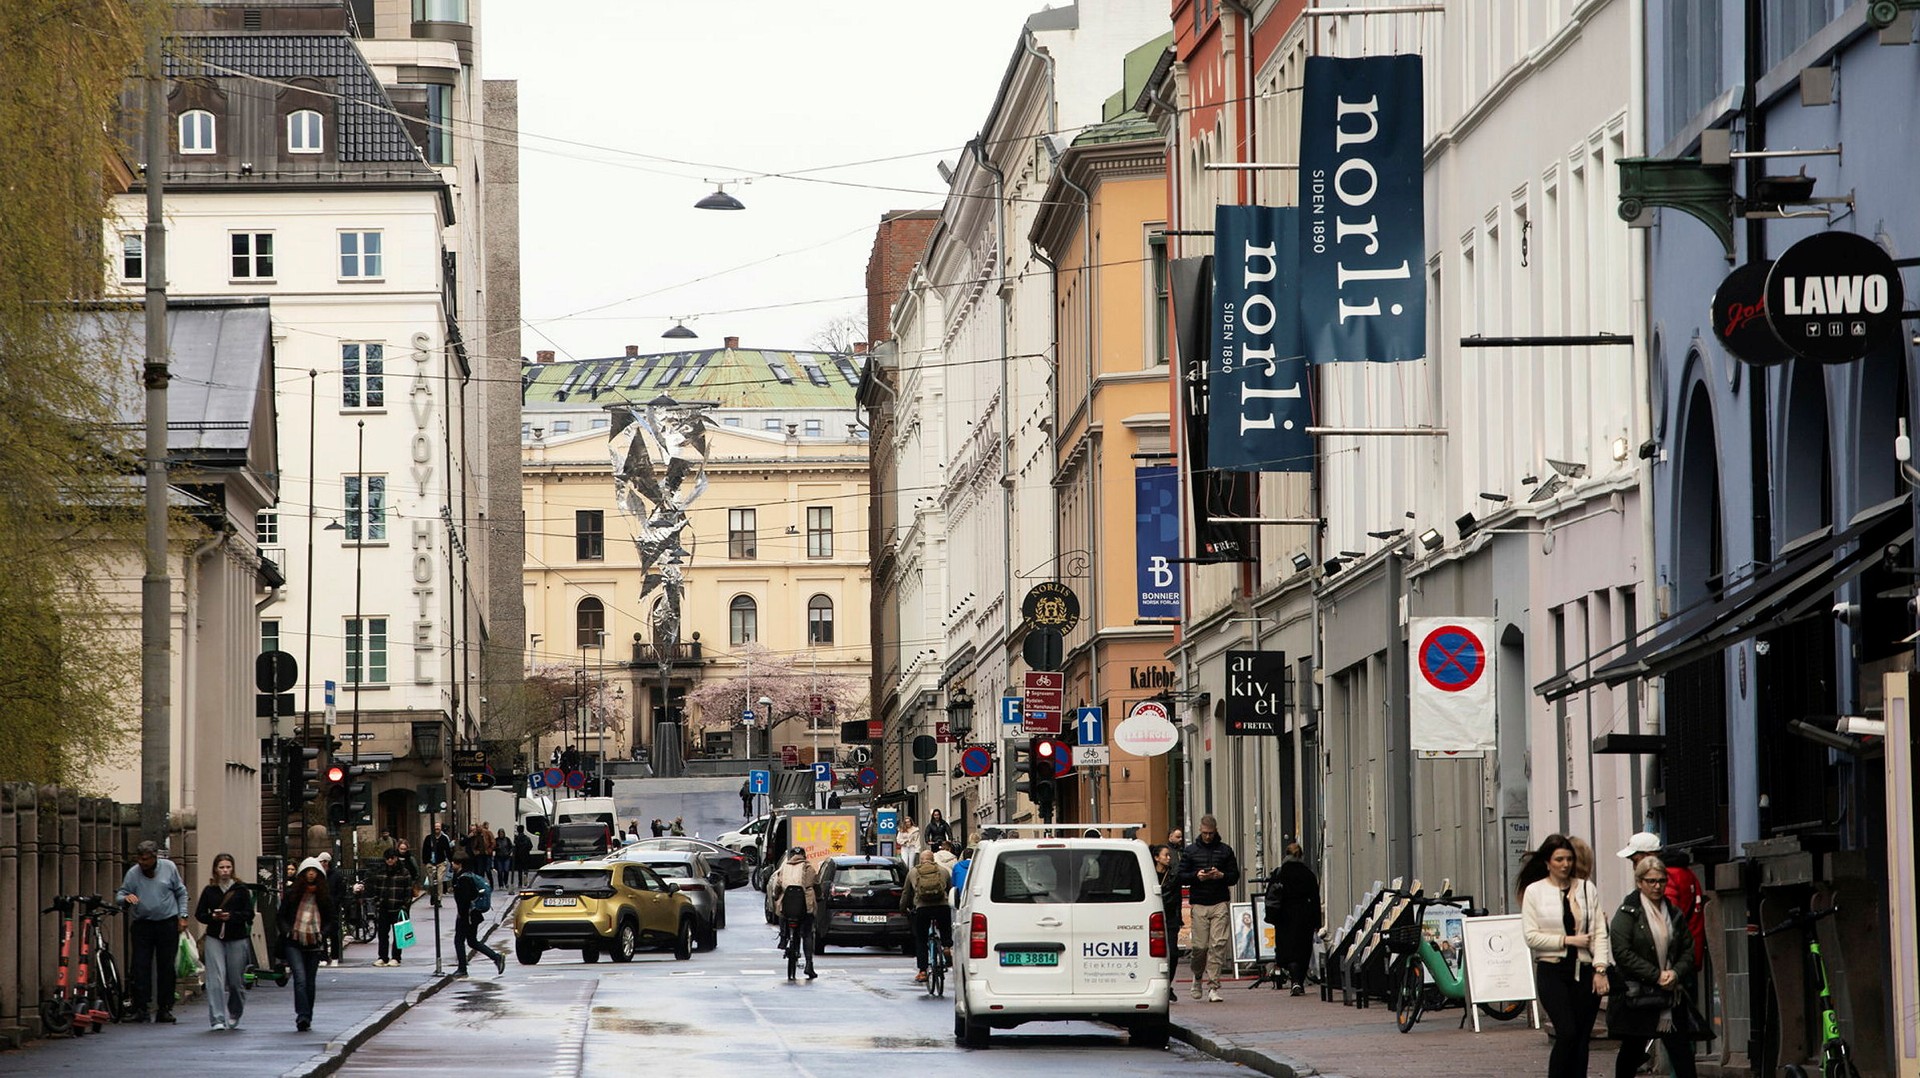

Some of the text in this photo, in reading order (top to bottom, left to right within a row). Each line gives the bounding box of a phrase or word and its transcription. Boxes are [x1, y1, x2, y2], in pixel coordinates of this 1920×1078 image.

[1312, 169, 1326, 254] SIDEN 1890
[1334, 95, 1411, 325] norli
[1784, 274, 1888, 315] LAWO
[1222, 302, 1235, 374] SIDEN 1890
[1240, 239, 1301, 437] norli
[1189, 386, 1211, 415] ki
[409, 331, 434, 686] SAVOY HOTEL
[1031, 583, 1071, 598] NORLIS
[1142, 592, 1180, 600] BONNIER
[1232, 657, 1256, 672] ar
[1232, 674, 1269, 697] kiv
[1255, 693, 1280, 715] et
[1243, 722, 1274, 732] FRETEX
[857, 749, 867, 763] b
[531, 774, 542, 788] P
[815, 764, 826, 780] P
[1083, 942, 1122, 956] HGN
[1488, 935, 1504, 953] C
[1008, 953, 1055, 962] DR 38814
